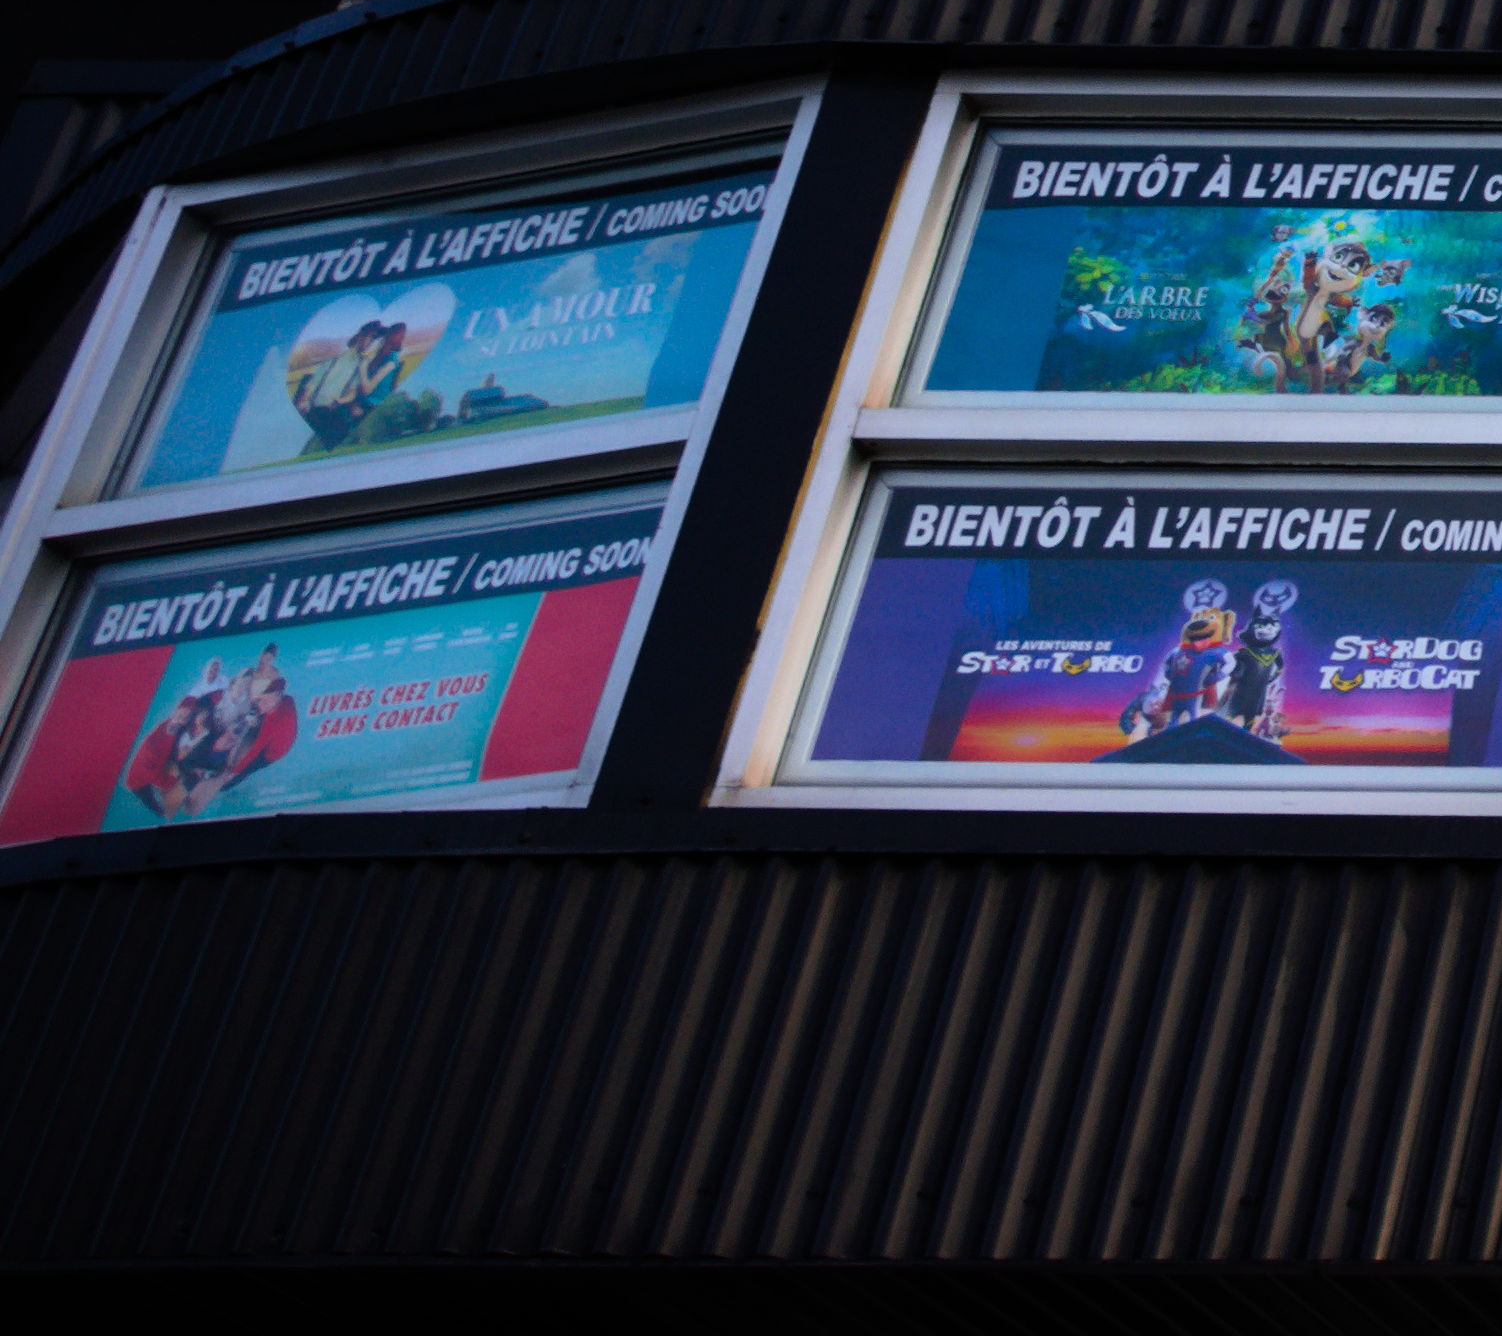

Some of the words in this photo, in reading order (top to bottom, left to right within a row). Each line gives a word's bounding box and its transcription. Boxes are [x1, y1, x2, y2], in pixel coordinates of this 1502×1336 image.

[1012, 153, 1199, 199] BIENTÔT
[1200, 154, 1231, 198] À
[1243, 163, 1455, 201] L'AFFICHE
[239, 239, 383, 301] BIENTÔT
[384, 236, 408, 275] À
[416, 207, 589, 269] L'AFFICHE
[608, 195, 708, 236] COMING
[1103, 285, 1209, 308] L'ARBRE
[904, 496, 1101, 548] BIENTÔT
[1104, 497, 1135, 548] À
[1149, 506, 1371, 550] L'AFFICHE
[93, 580, 248, 646] BIENTÔT
[244, 572, 279, 623] À
[276, 555, 460, 619] L'AFFICHE
[474, 549, 579, 591] COMING
[996, 640, 1018, 651] LES
[1020, 640, 1093, 651] AVENTURES
[1095, 640, 1112, 651] DE
[309, 687, 375, 715] LIVRÉS
[380, 680, 431, 708] CHEZ
[437, 673, 488, 700] VOUS
[317, 711, 367, 739] SANS
[371, 702, 459, 730] CONTACT
